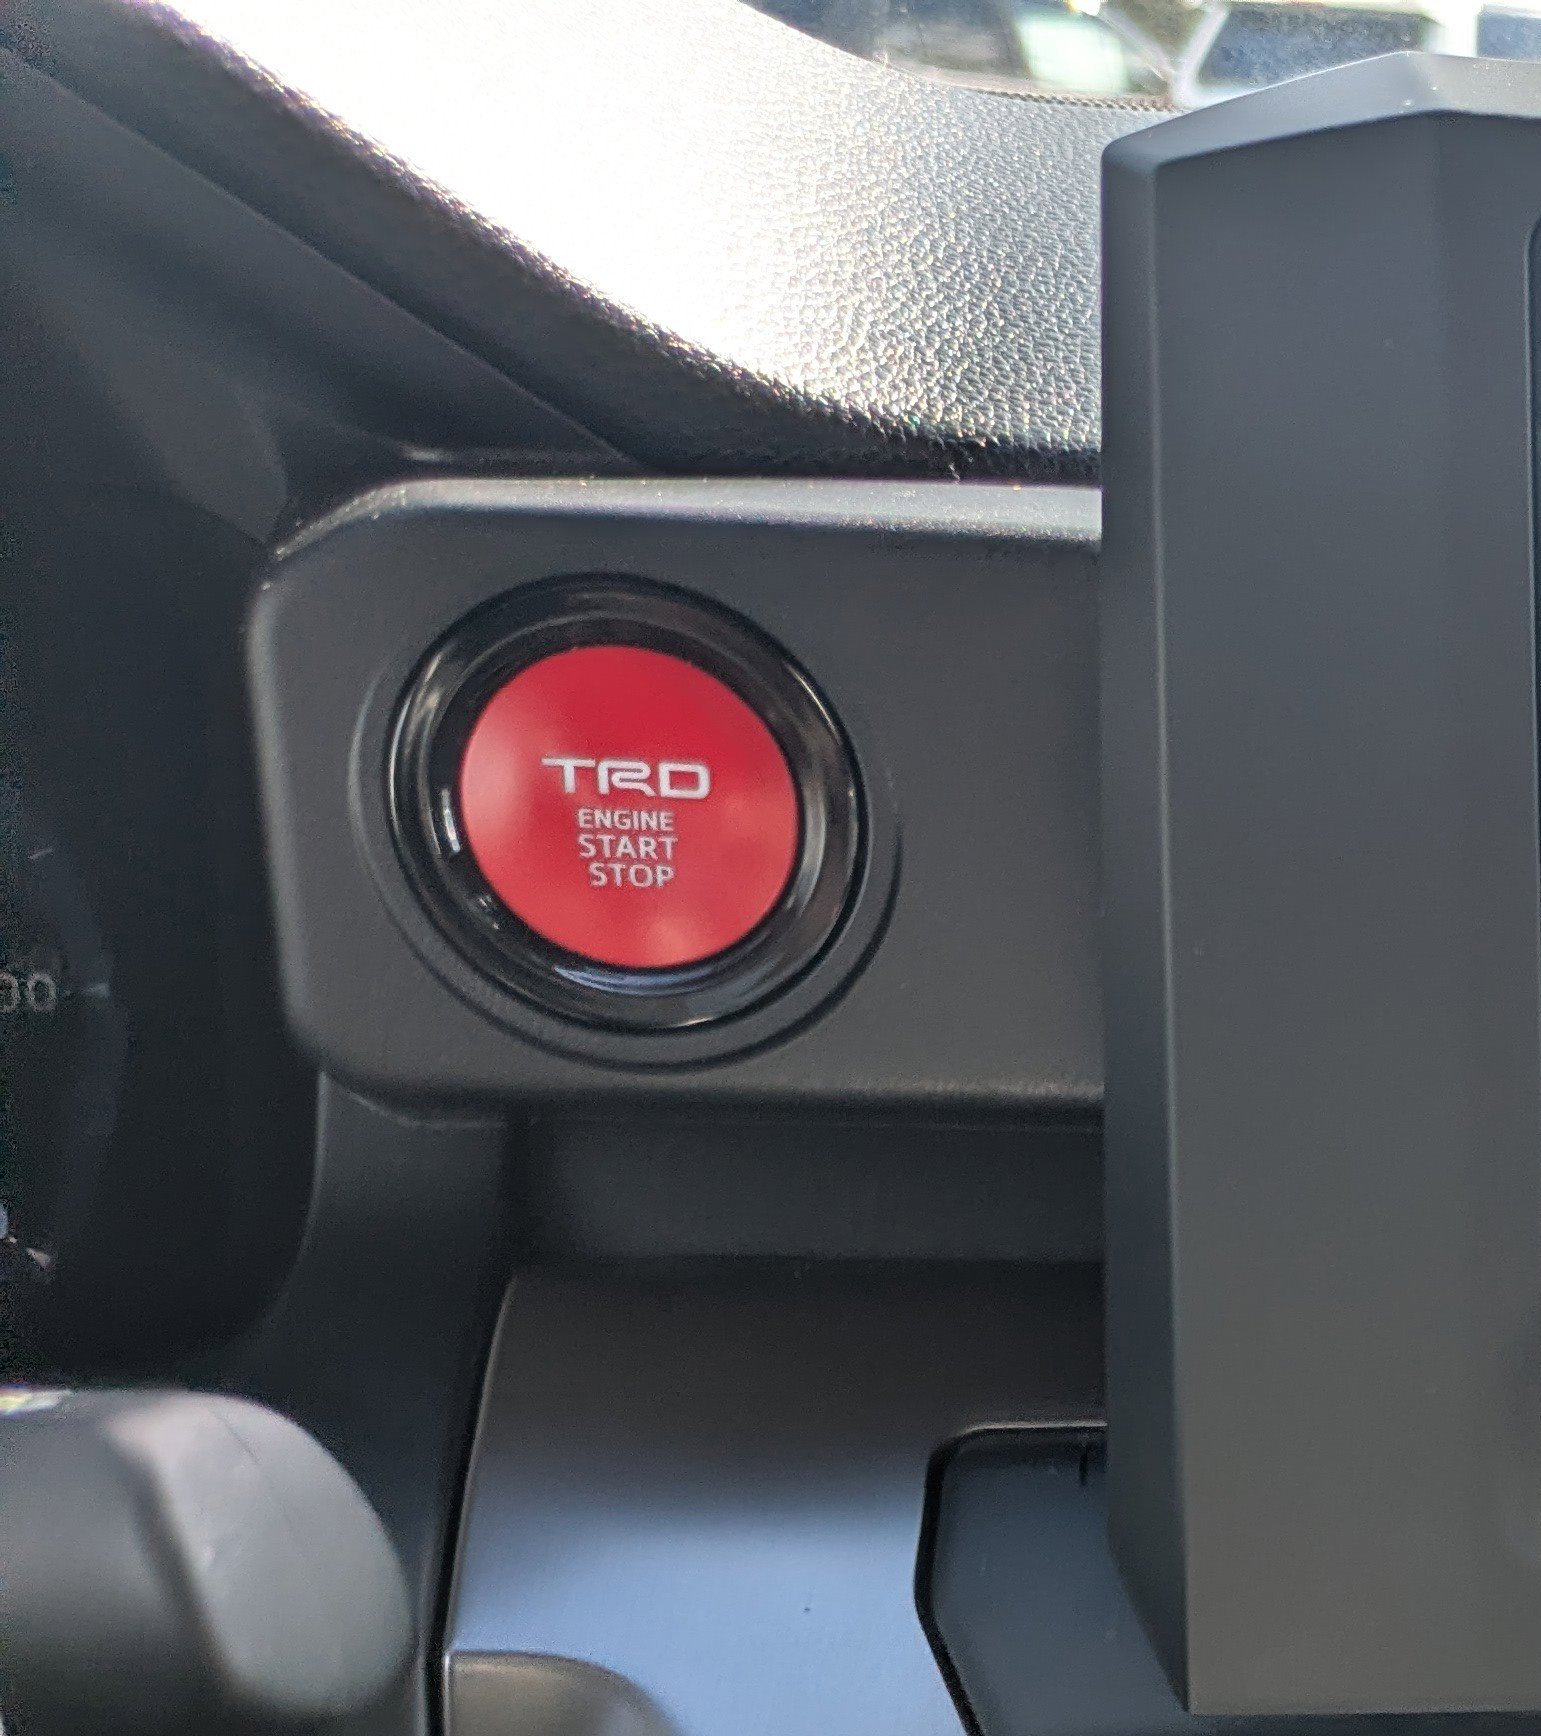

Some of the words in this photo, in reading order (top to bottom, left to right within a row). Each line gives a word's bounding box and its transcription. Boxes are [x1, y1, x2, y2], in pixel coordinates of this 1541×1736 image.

[541, 755, 711, 800] TRD
[577, 808, 675, 832] ENGINE
[578, 833, 678, 860] START
[588, 862, 676, 888] STOP
